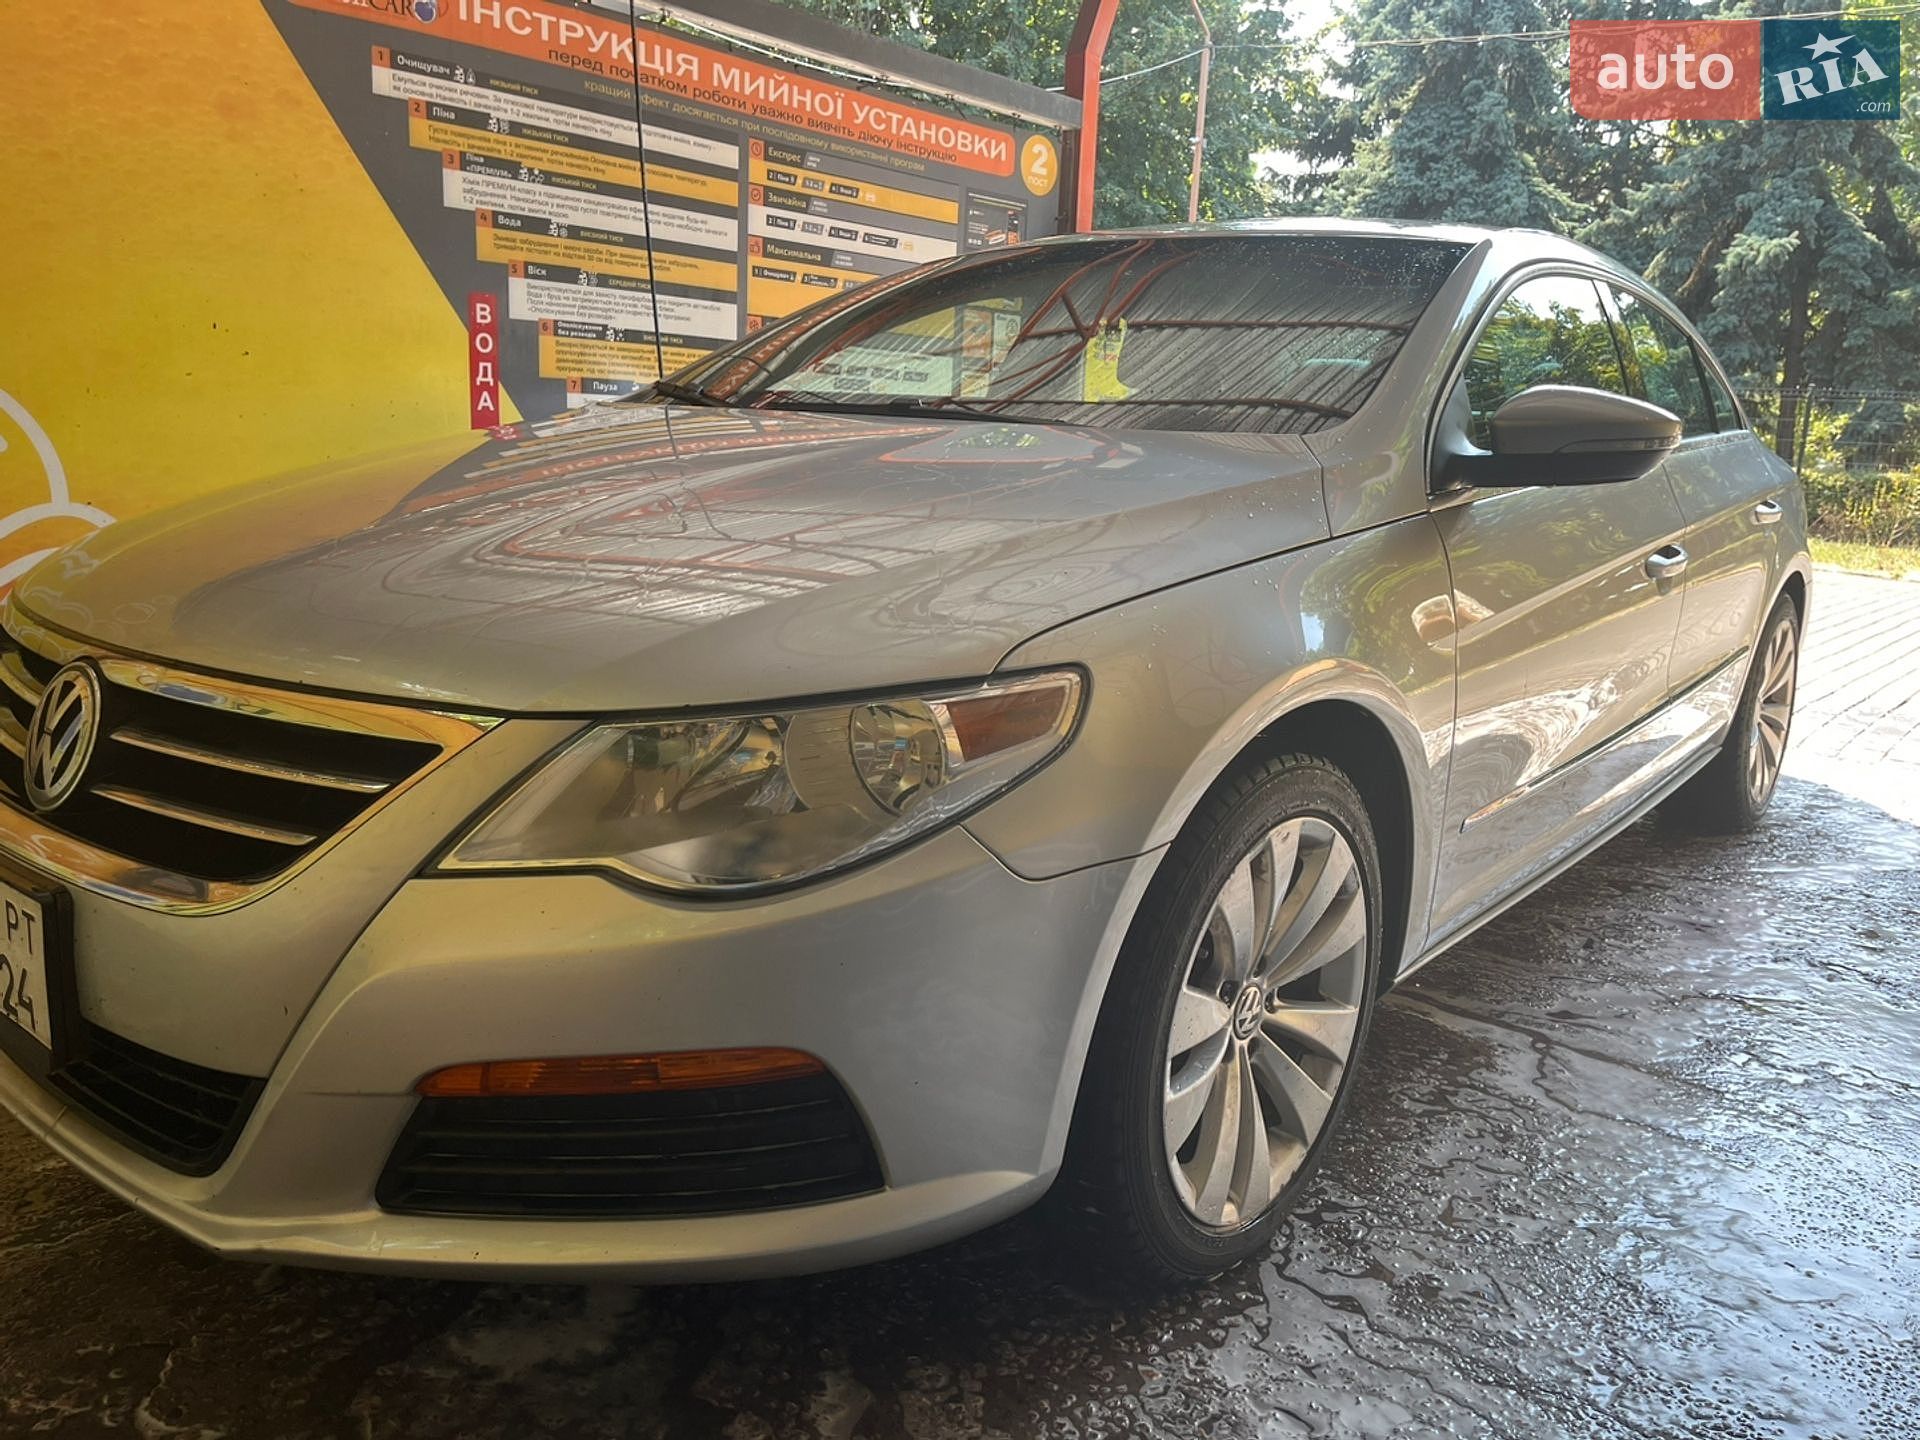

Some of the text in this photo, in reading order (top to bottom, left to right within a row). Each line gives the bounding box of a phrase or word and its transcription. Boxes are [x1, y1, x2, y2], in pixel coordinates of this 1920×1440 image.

[397, 55, 450, 76] Очищувач
[459, 0, 1006, 161] ІНСТРУКЦІЯ МИЙНОЇ УСТАНОВКИ
[414, 102, 420, 113] 2
[432, 107, 455, 120] Піна
[548, 49, 957, 163] перед початком роботи уважно вивчіть діючу інструкцію
[448, 154, 454, 164] 3
[767, 146, 801, 163] Експрес
[1031, 144, 1048, 176] 2
[767, 191, 806, 208] Звичайна
[497, 214, 522, 227] Вода
[767, 242, 822, 262] Максимальна
[511, 264, 518, 273] 5
[527, 265, 547, 277] Віск
[542, 321, 548, 332] 6
[475, 302, 495, 411] ВОДА
[571, 380, 618, 393] 7 Пауза
[0, 953, 36, 1033] 24
